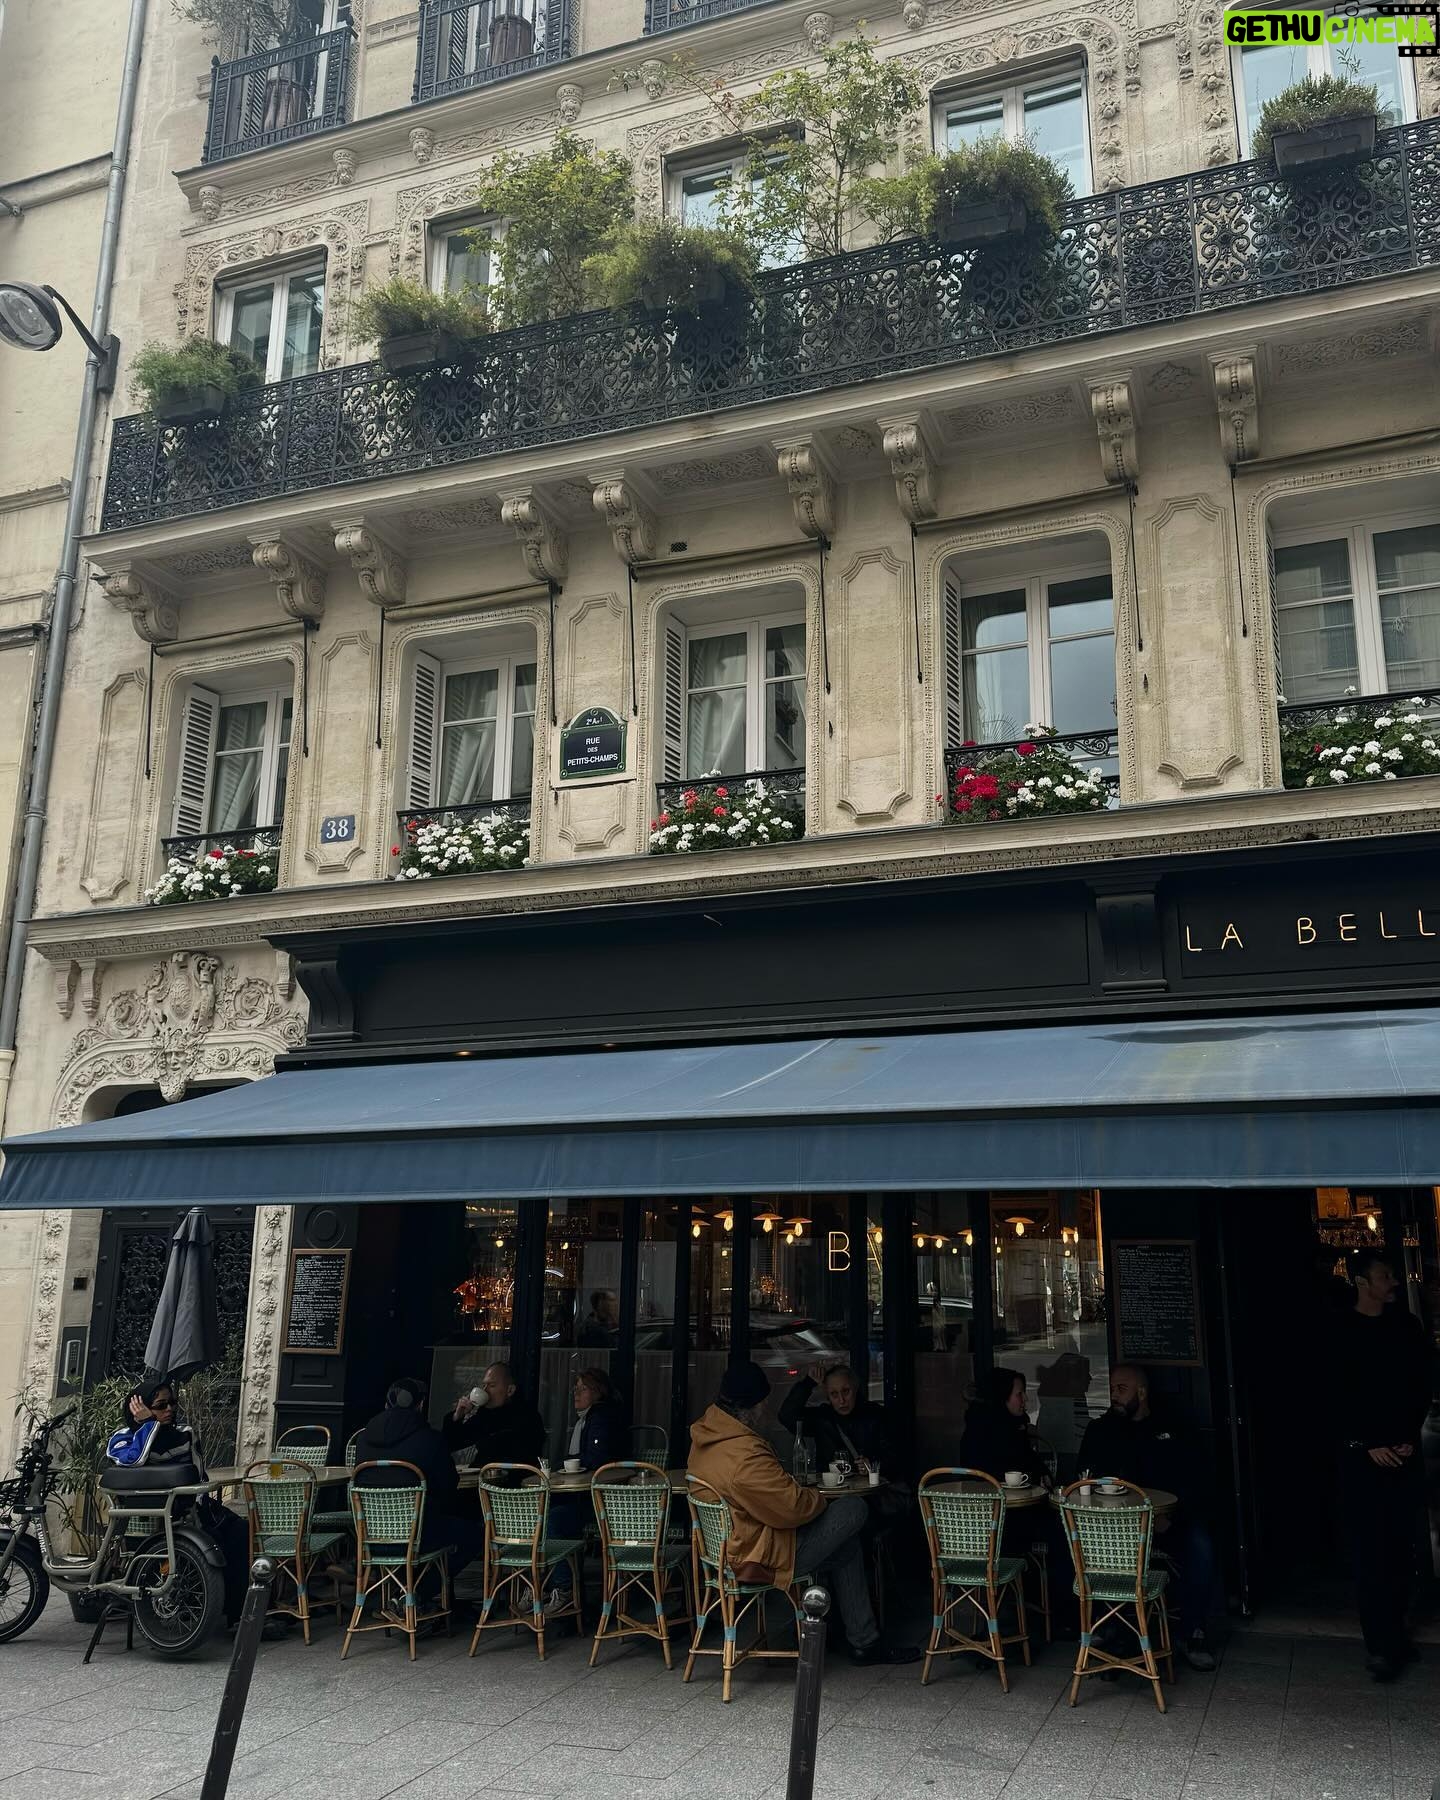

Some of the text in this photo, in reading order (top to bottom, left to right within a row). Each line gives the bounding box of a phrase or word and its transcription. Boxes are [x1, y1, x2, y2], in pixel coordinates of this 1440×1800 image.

[586, 737, 600, 745] RUE
[567, 753, 618, 767] PETITS-CHAMPS
[326, 818, 349, 839] 38
[1186, 909, 1436, 952] LA BELL
